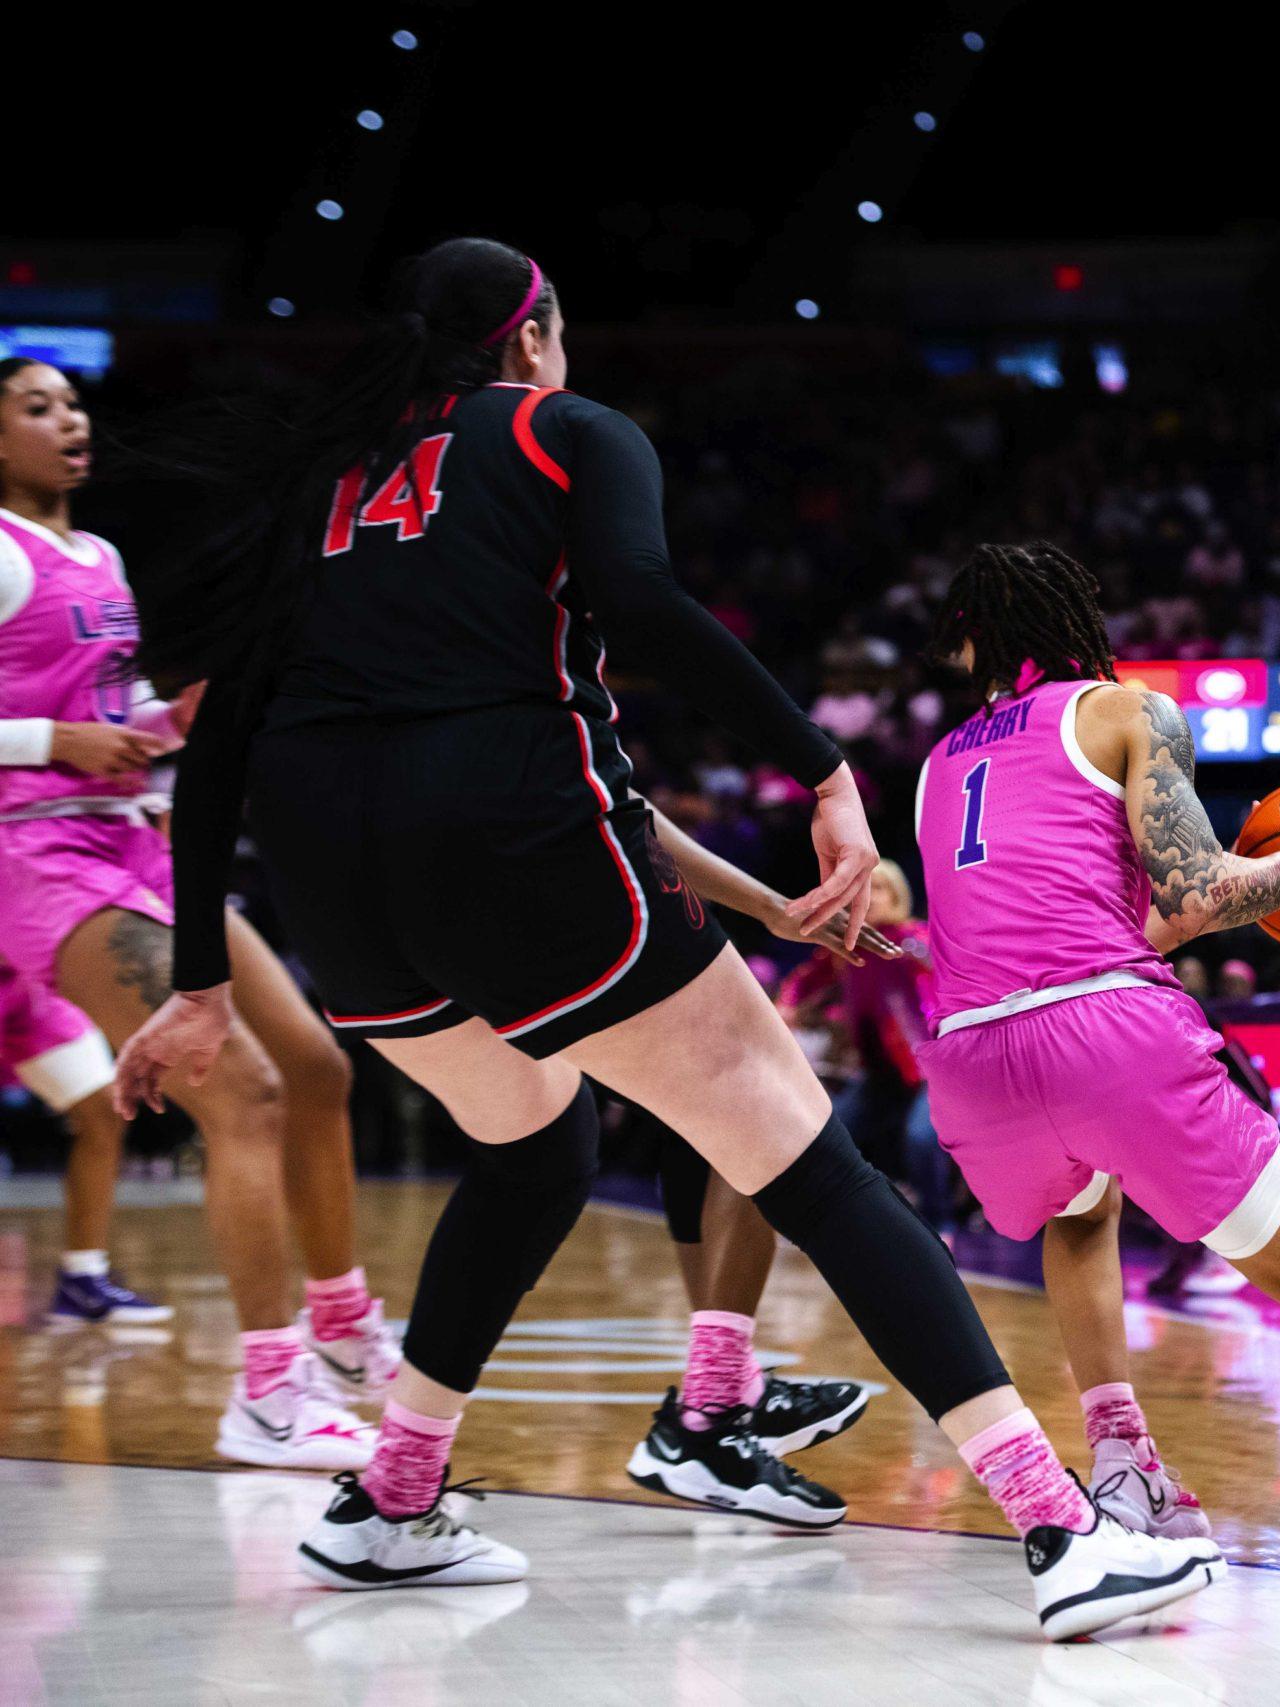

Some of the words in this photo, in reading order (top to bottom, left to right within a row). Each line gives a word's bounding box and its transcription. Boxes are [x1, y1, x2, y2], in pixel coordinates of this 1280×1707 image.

[322, 432, 454, 558] 14
[946, 696, 1036, 757] CHERRY
[955, 757, 991, 871] 1
